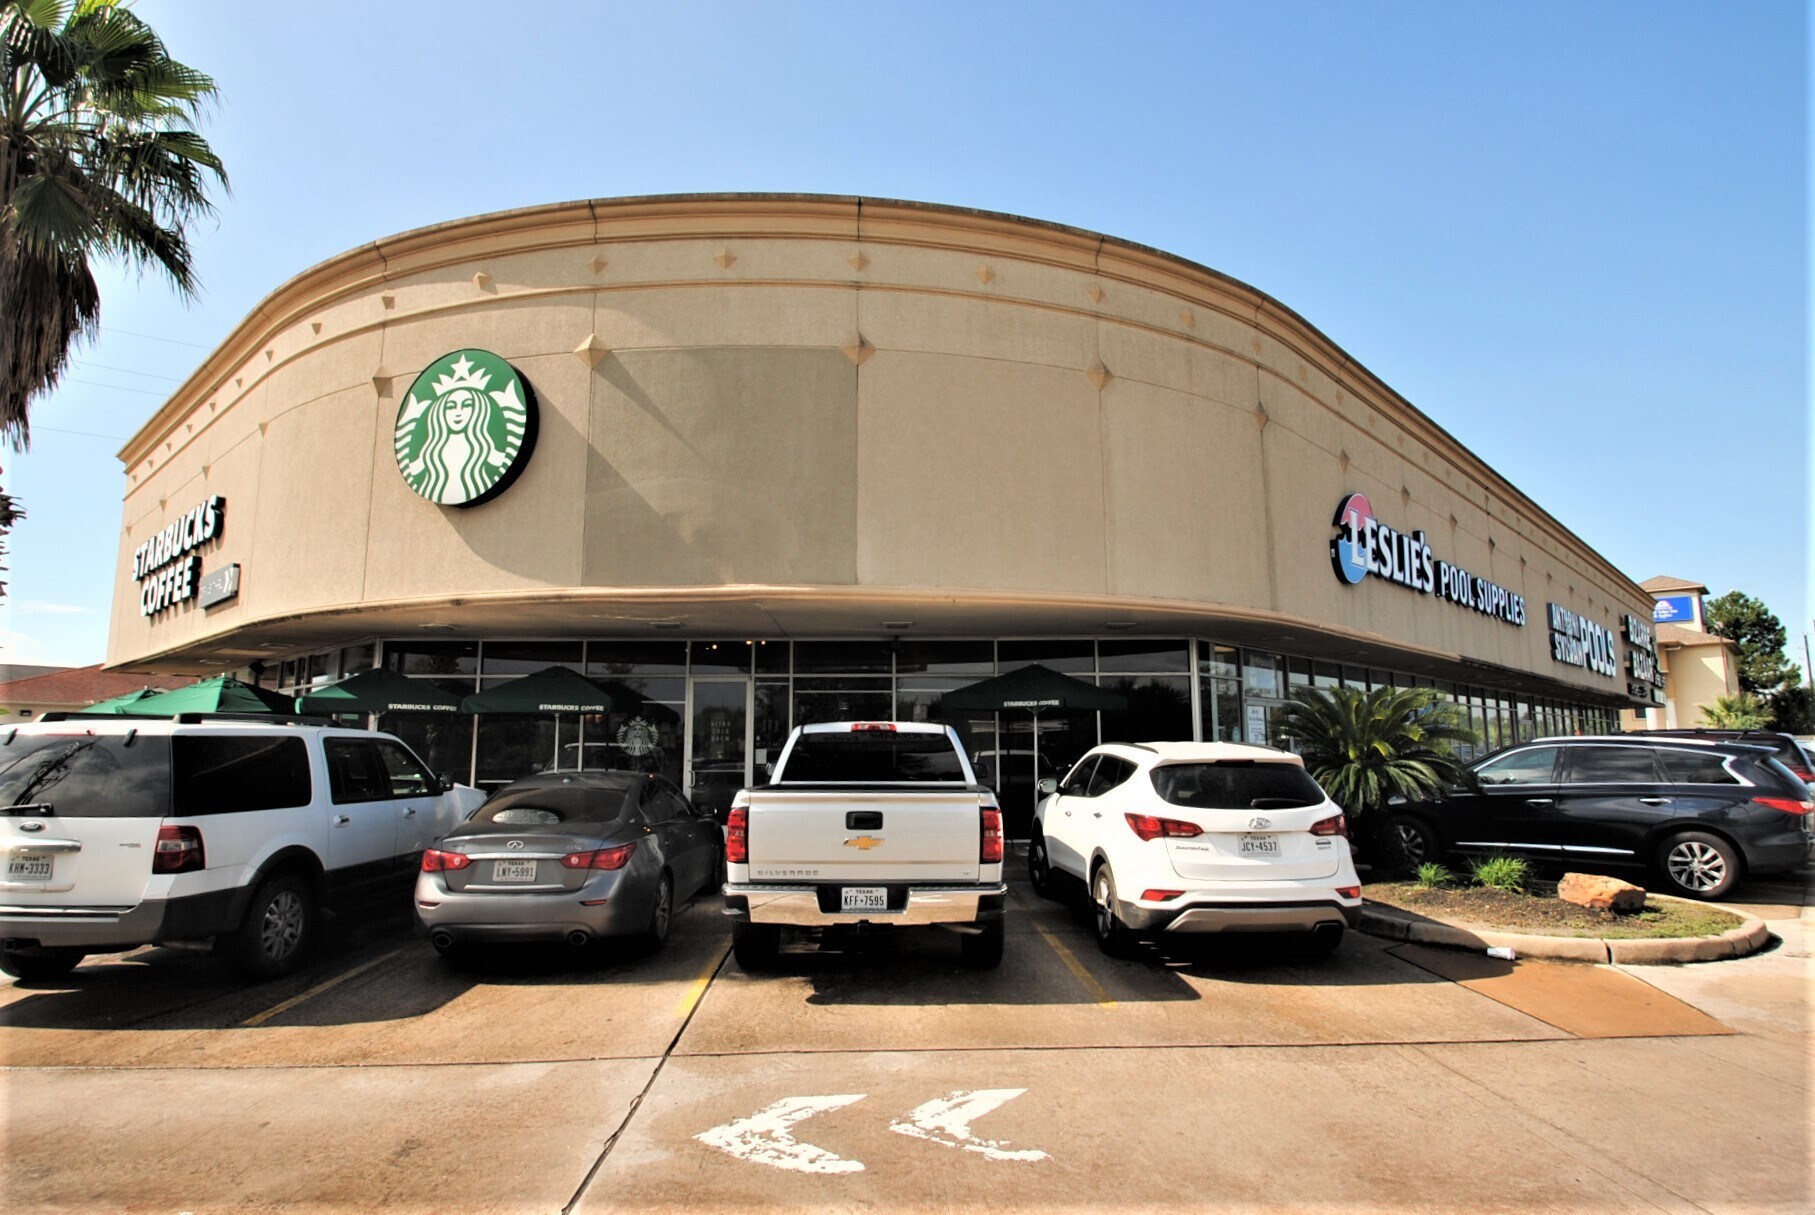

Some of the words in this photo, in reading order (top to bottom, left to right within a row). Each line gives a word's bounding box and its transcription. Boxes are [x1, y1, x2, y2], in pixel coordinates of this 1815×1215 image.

[132, 494, 223, 581] STARBUCKS
[1348, 507, 1434, 594] LESLIE'S
[1439, 560, 1475, 607] POOL
[1476, 577, 1525, 626] SUPPLIES
[140, 555, 199, 617] COFFEE
[1579, 615, 1616, 677] POOLS
[388, 703, 431, 711] STARBUCKS
[539, 703, 579, 711] STARBUCKS
[580, 704, 604, 712] COFFEE
